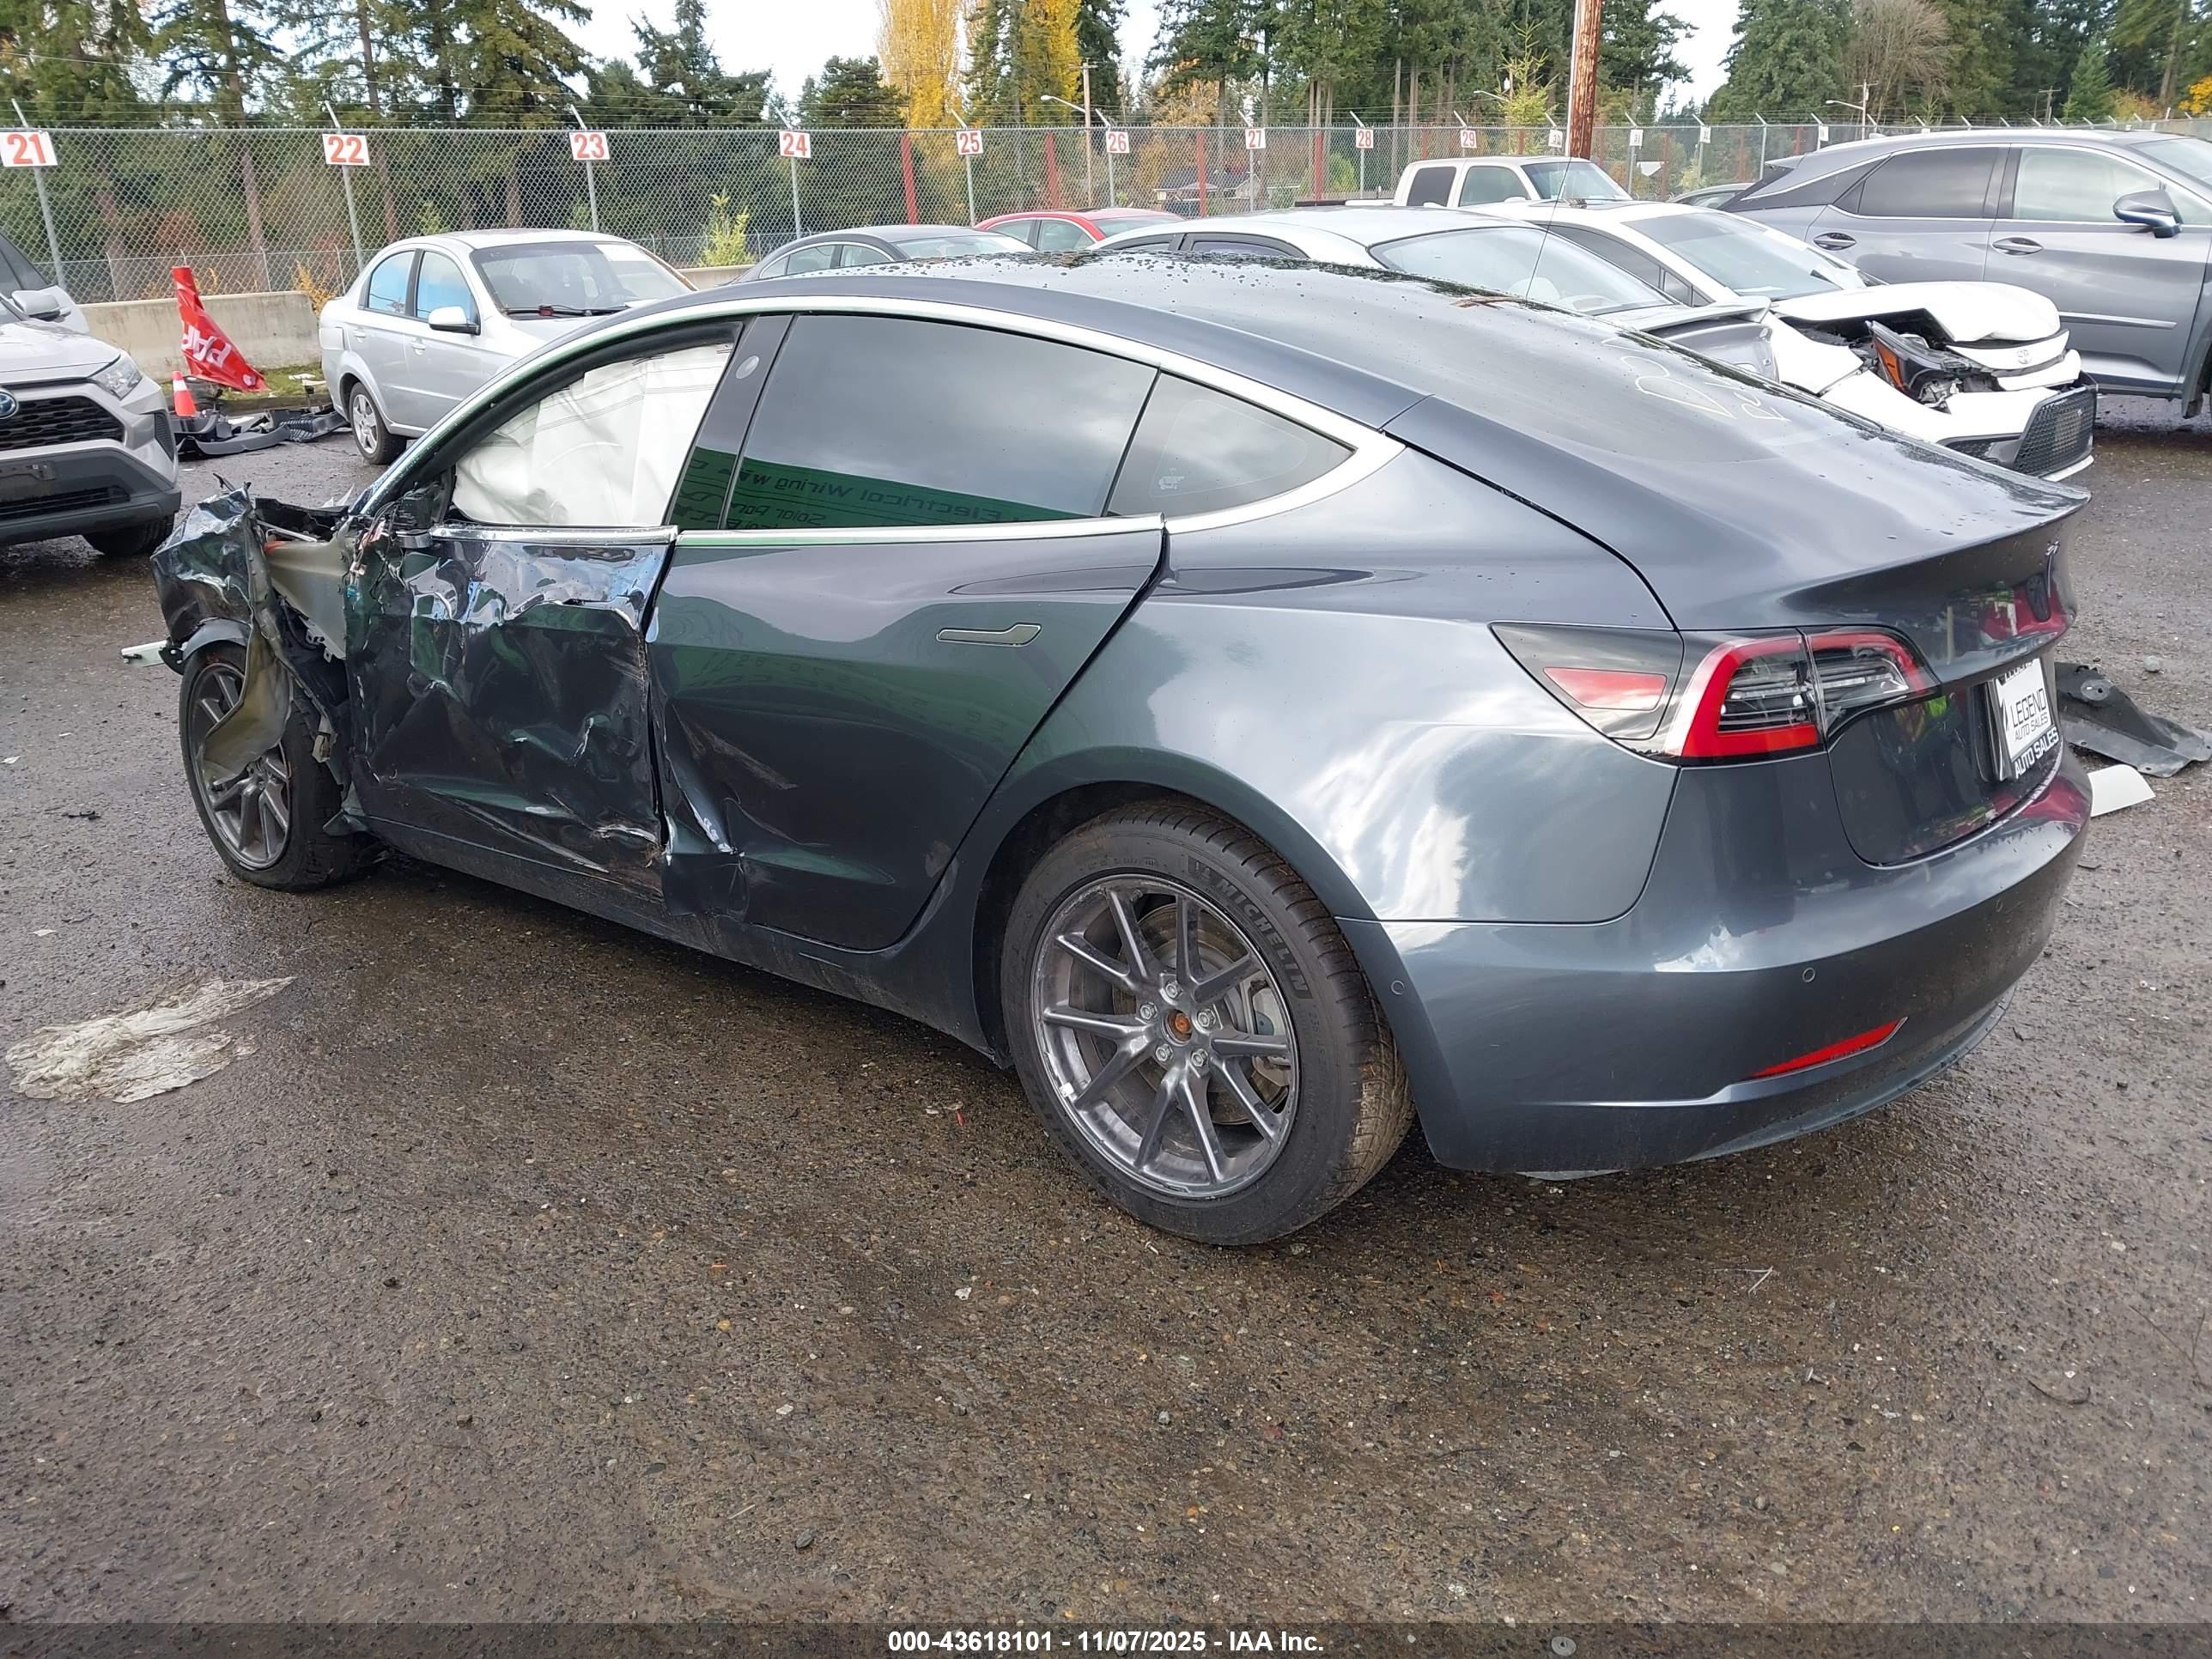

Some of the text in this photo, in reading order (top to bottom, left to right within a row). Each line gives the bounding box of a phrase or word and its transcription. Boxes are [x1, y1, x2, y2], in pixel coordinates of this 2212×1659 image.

[7, 133, 46, 164] 21
[328, 136, 363, 164] 22
[574, 133, 605, 159] 23
[782, 133, 810, 156] 24
[959, 132, 980, 154] 25
[1108, 132, 1127, 151] 26
[1248, 130, 1261, 148] 27
[1358, 131, 1371, 148] 28
[1462, 131, 1475, 147] 29
[2009, 688, 2046, 728] LEGEND
[2014, 712, 2049, 743] AUTO SALES
[2014, 726, 2059, 780] AUTO SALES
[1219, 880, 1310, 992] MICHELIN
